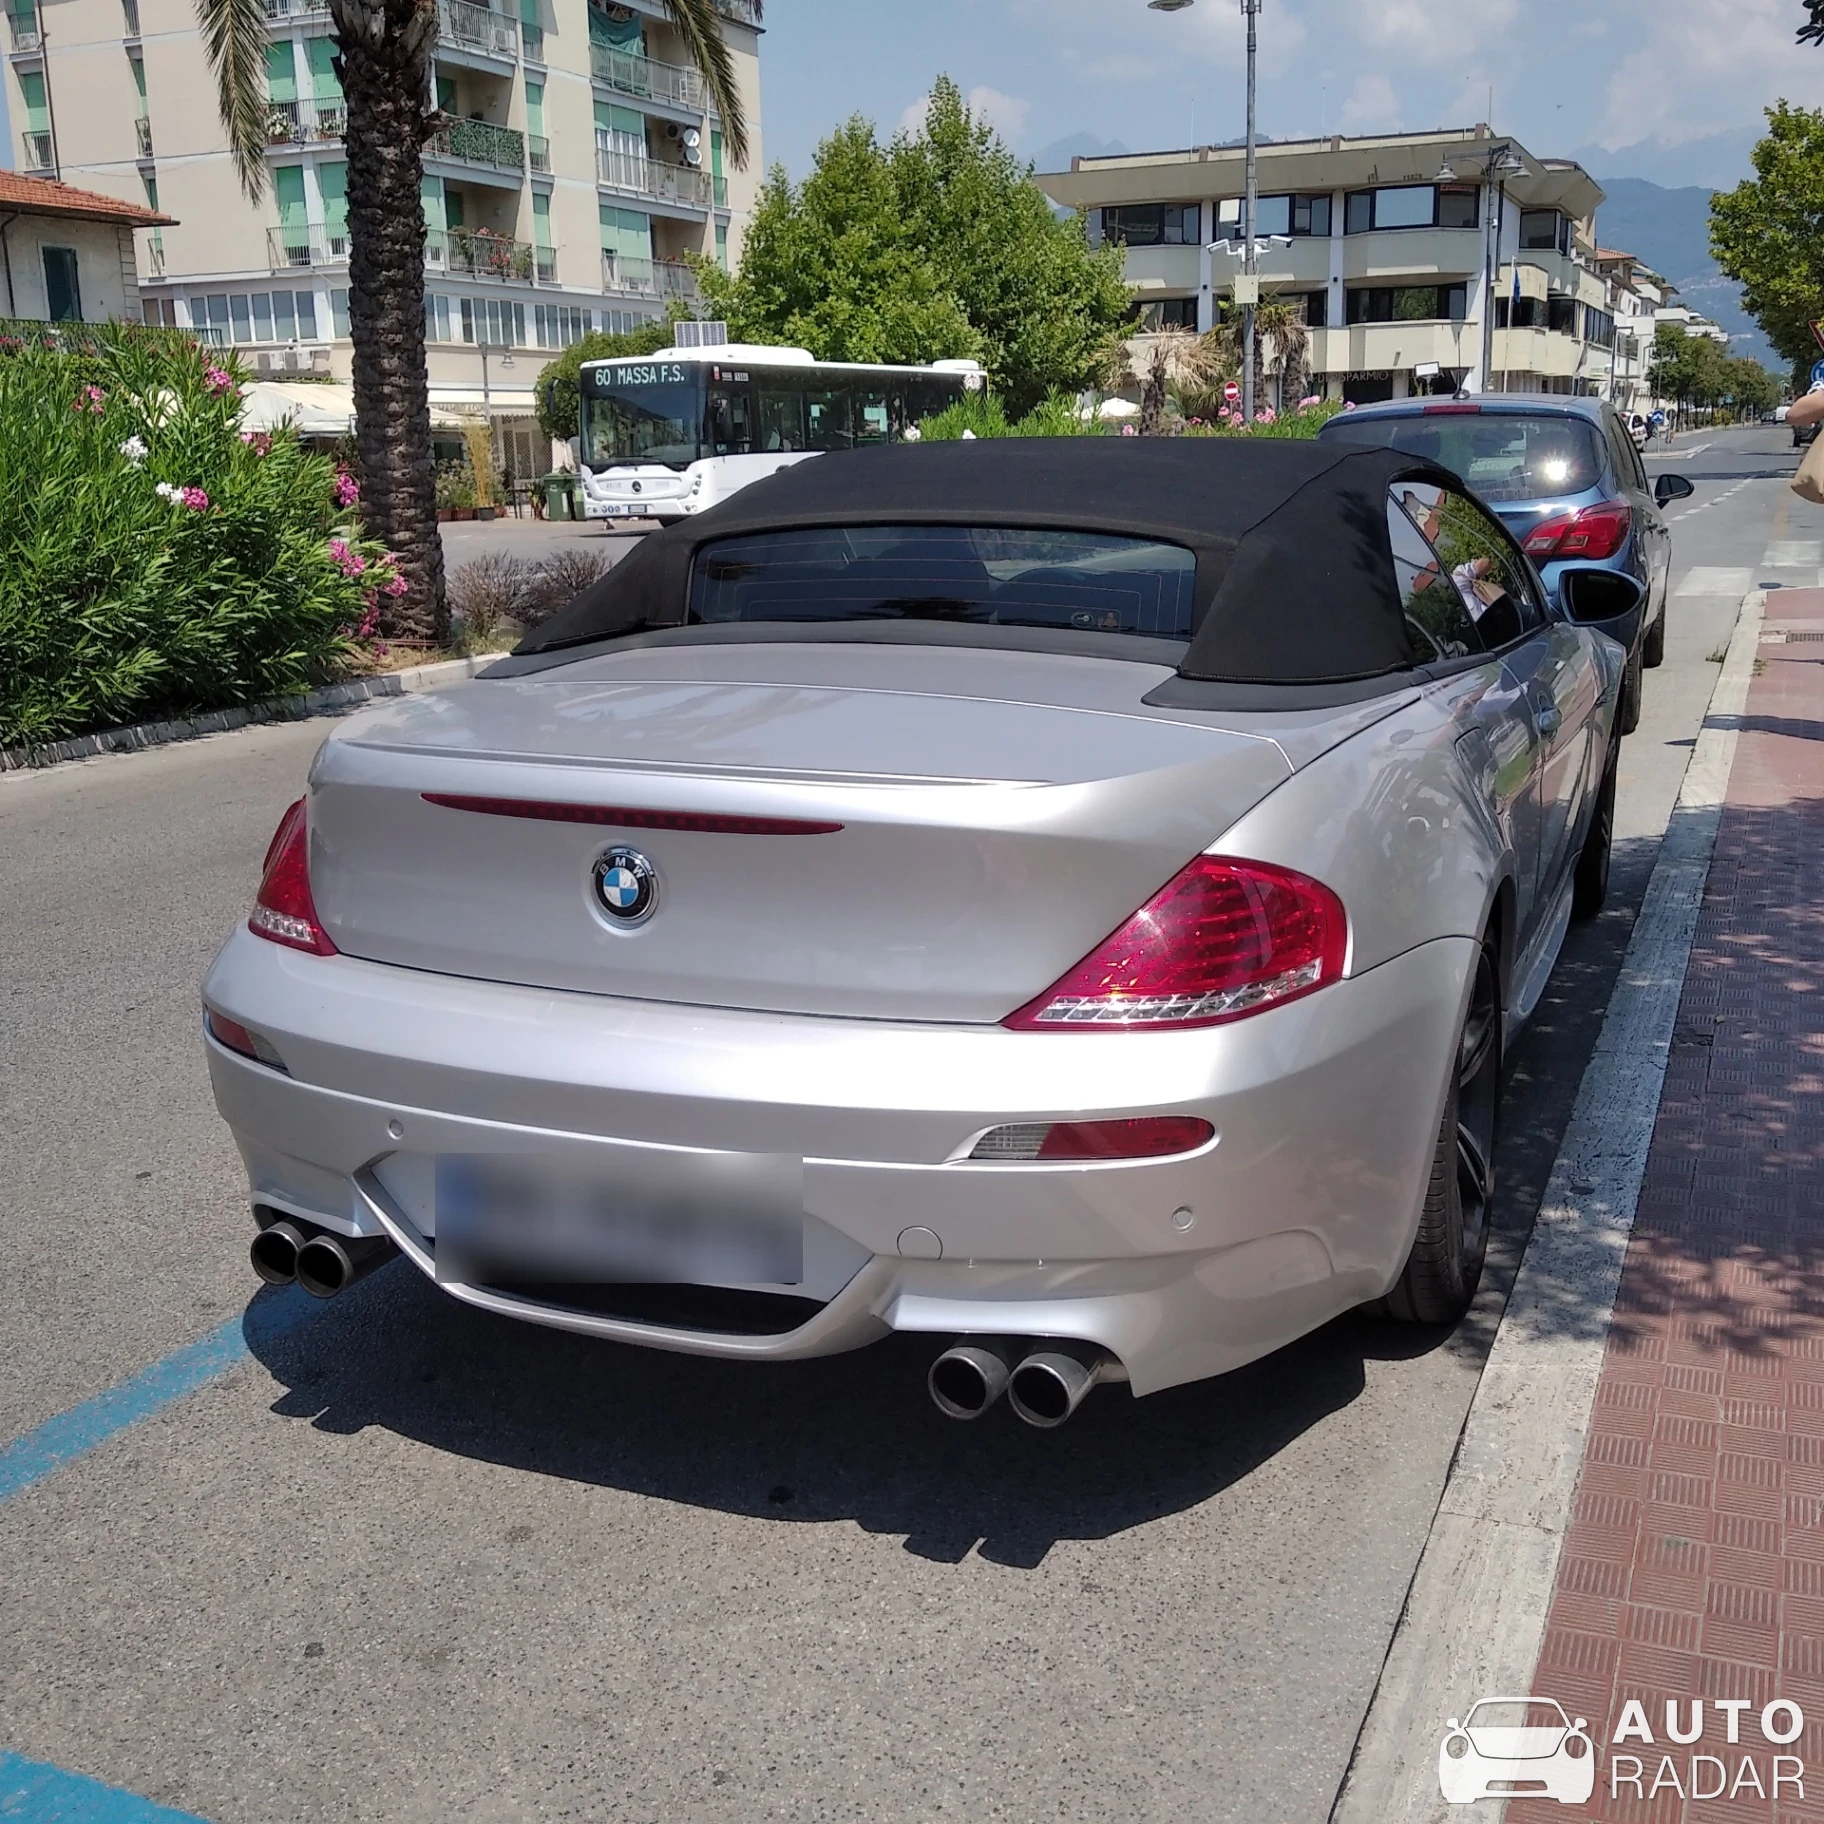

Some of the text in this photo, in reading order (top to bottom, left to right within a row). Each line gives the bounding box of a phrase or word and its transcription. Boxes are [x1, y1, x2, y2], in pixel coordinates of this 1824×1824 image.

[595, 364, 685, 386] 60 MASSA F.S.
[599, 856, 645, 879] BMW
